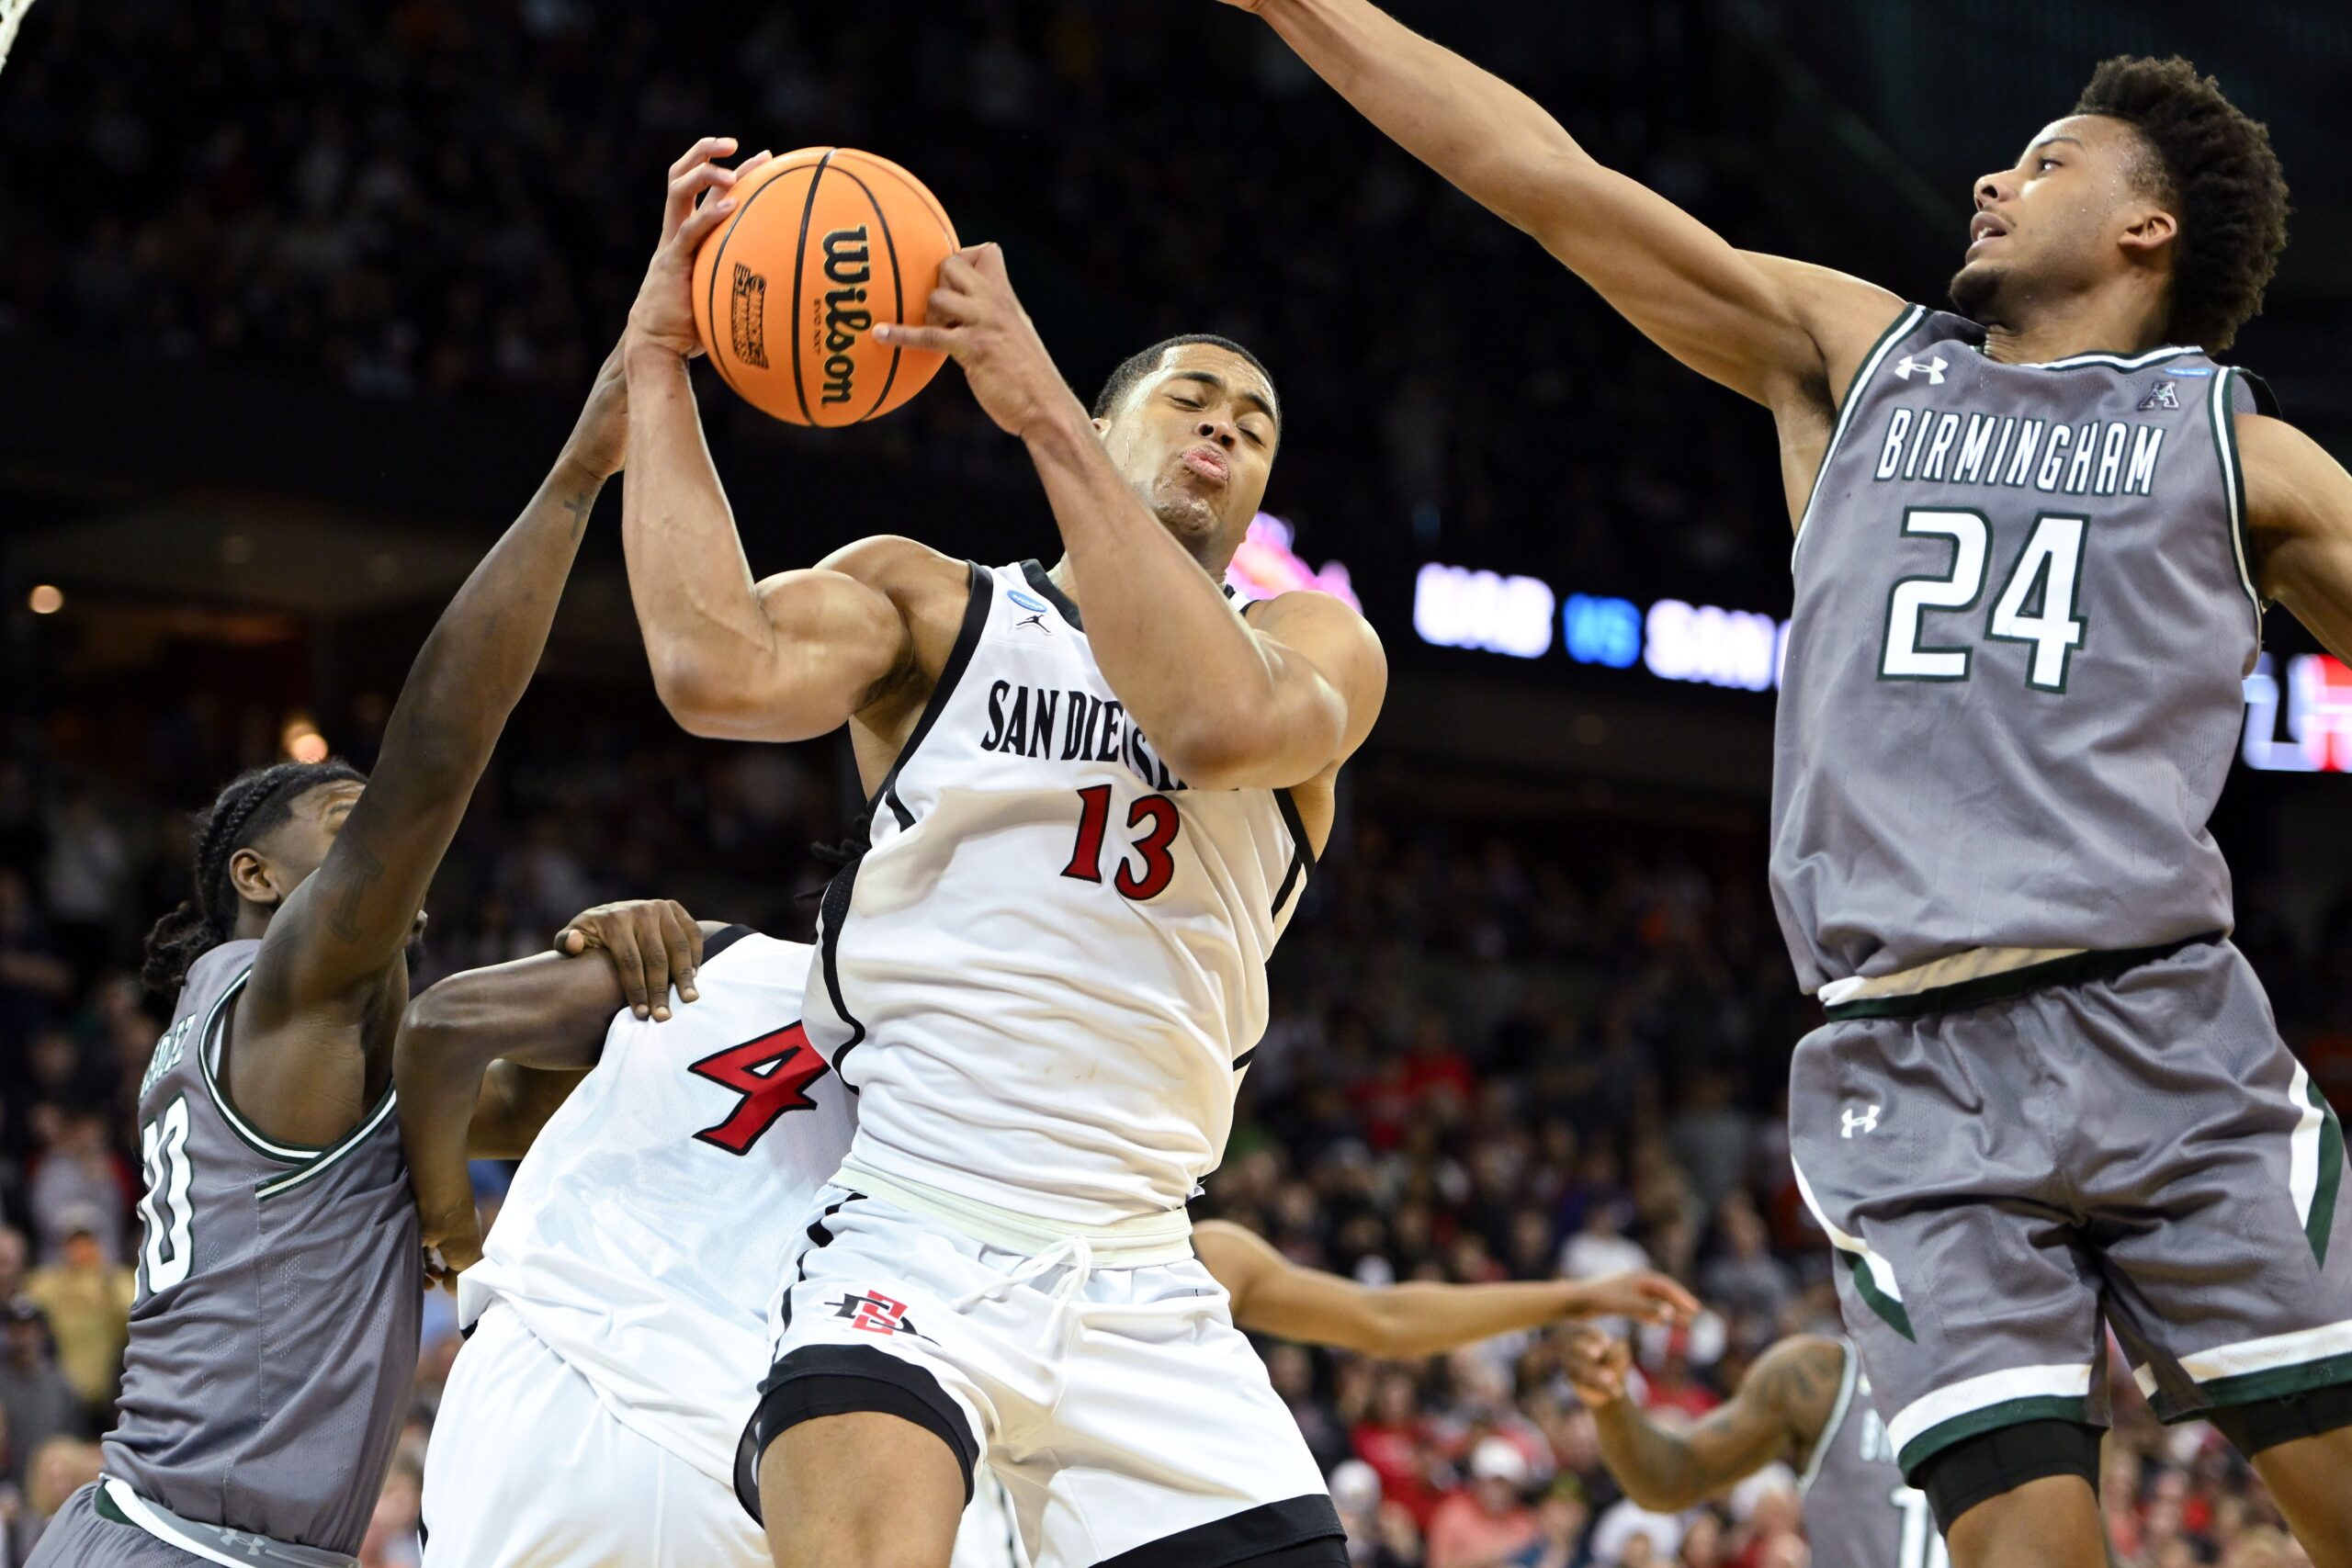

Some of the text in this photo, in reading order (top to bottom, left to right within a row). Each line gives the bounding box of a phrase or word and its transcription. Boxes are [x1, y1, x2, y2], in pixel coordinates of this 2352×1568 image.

[821, 224, 873, 406] Wilson
[1873, 408, 2166, 496] BIRMINGHAM
[1877, 505, 2090, 694] 24
[980, 680, 1059, 760] SAN
[1060, 690, 1130, 769] DIE
[1059, 784, 1181, 901] 13
[687, 1019, 831, 1156] 4
